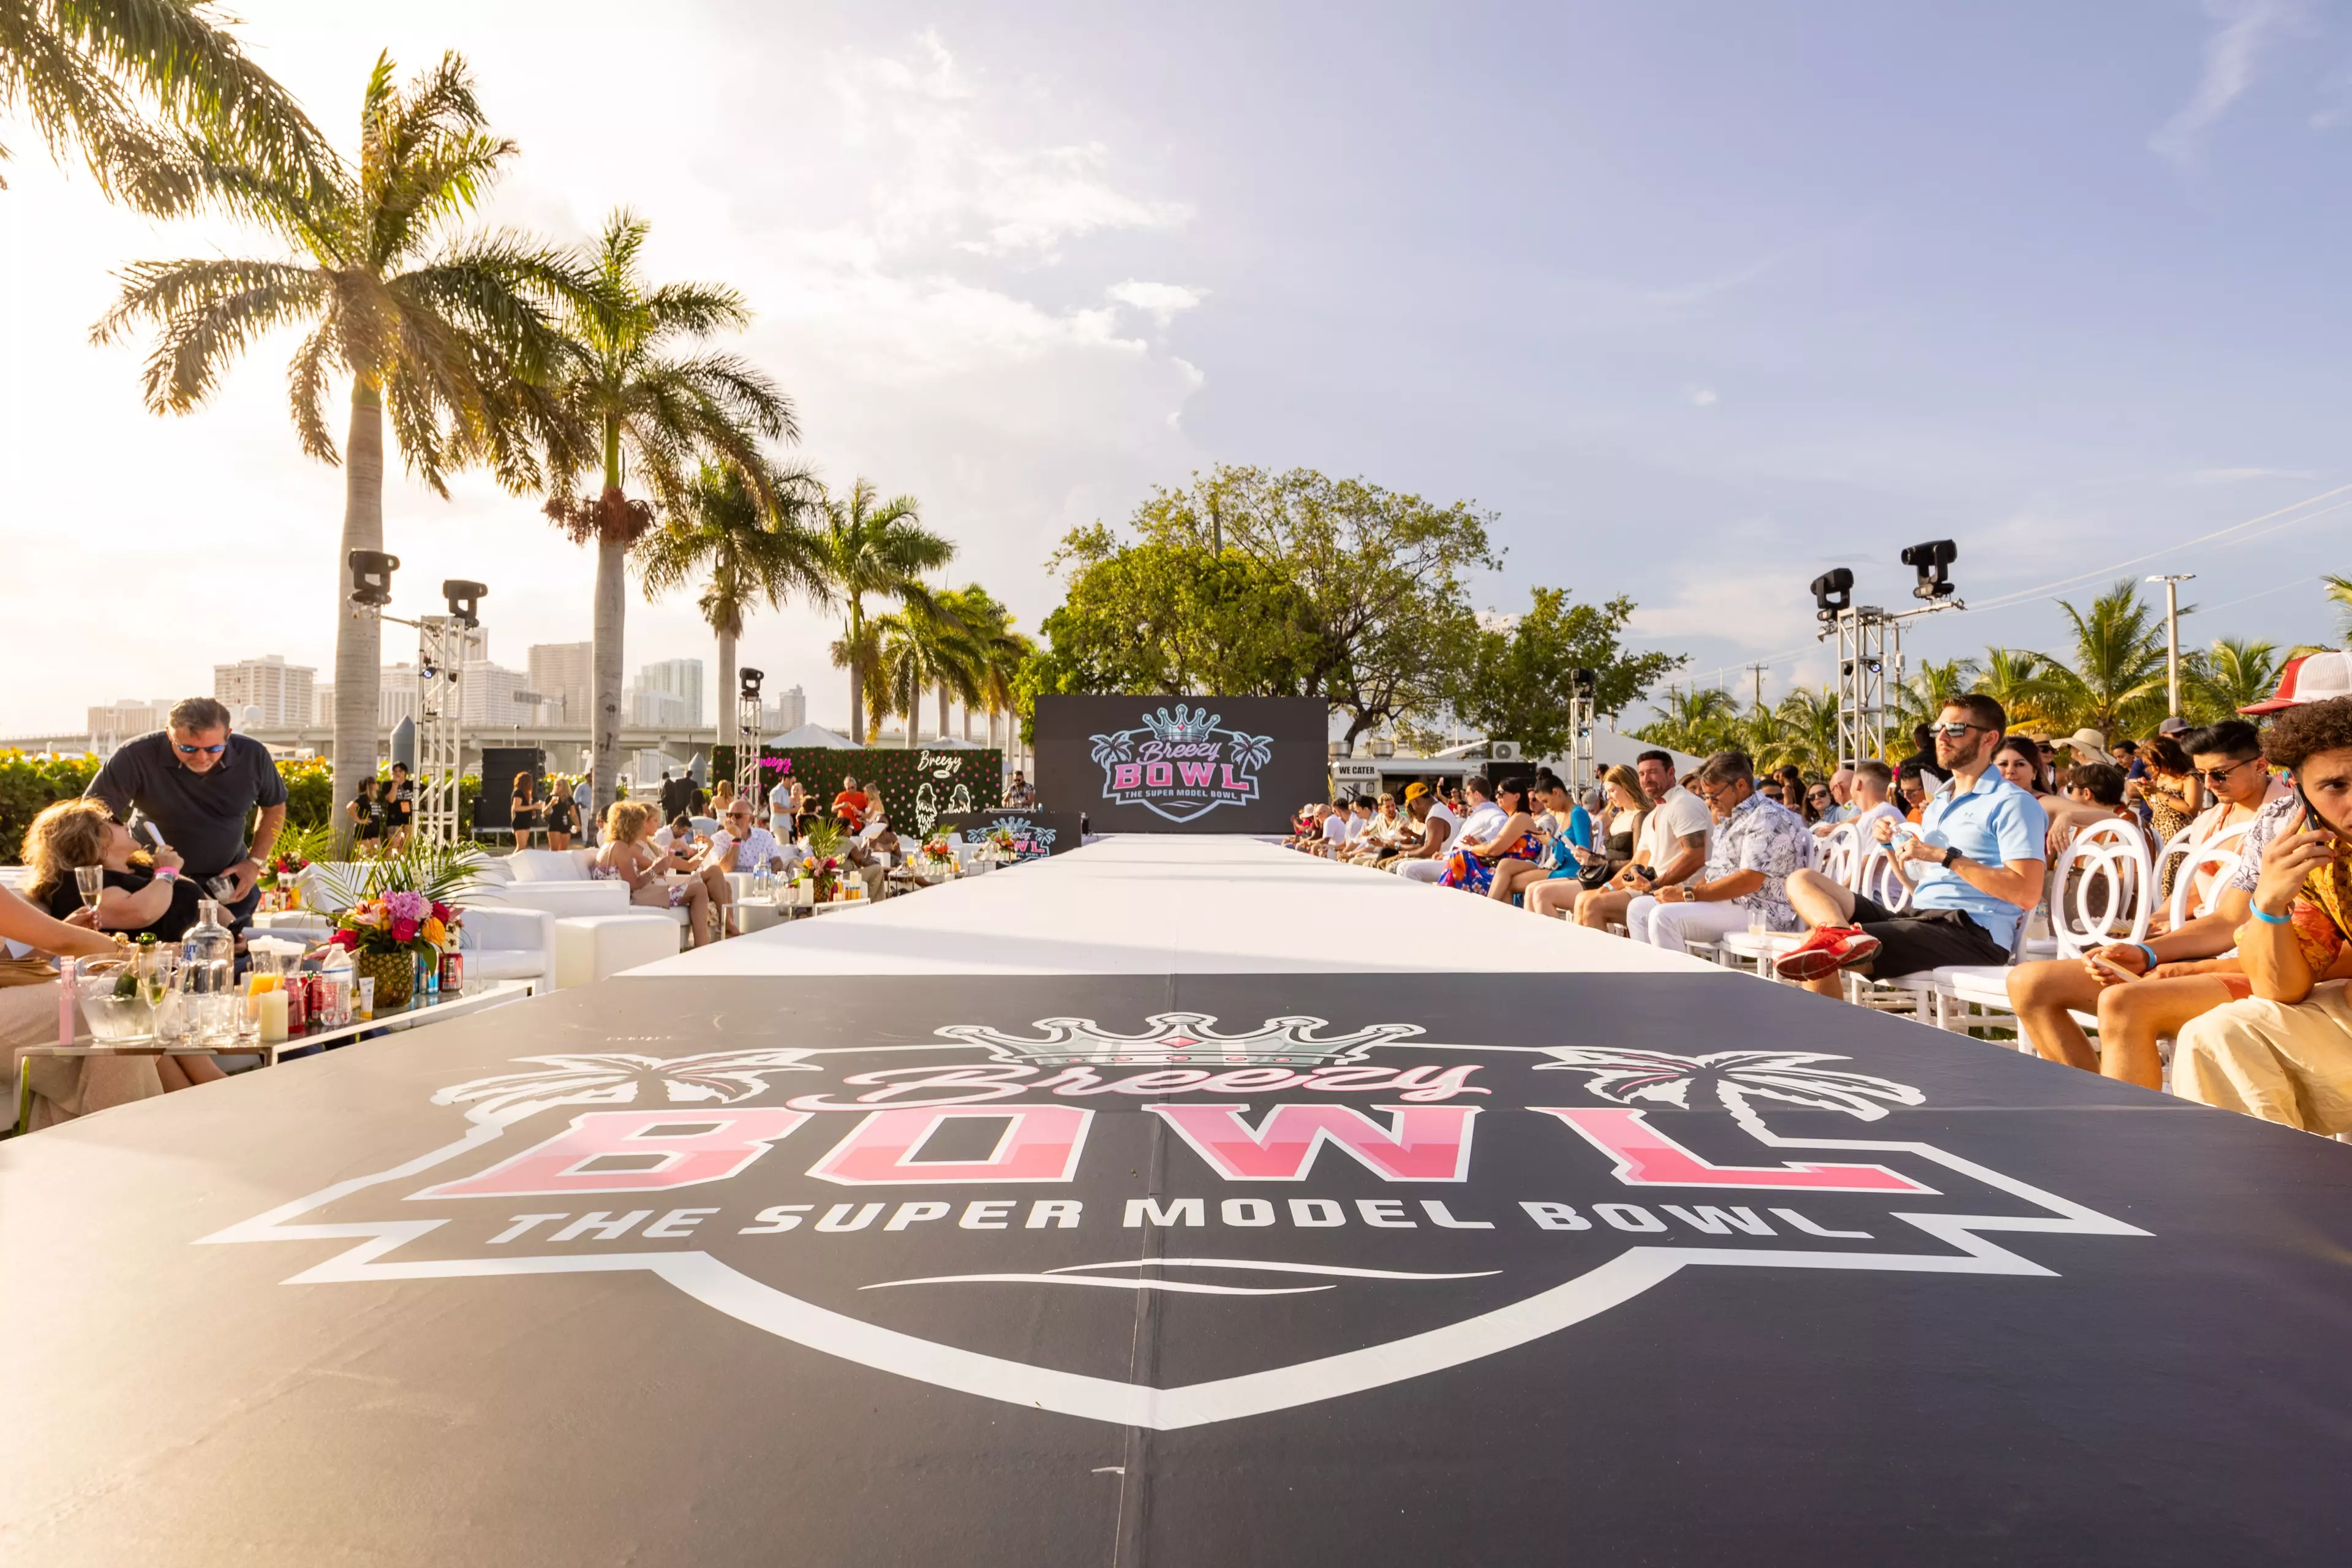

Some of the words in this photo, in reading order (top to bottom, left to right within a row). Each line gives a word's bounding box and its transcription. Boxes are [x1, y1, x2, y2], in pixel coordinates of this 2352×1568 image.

[760, 757, 791, 774] reezy
[918, 750, 962, 773] Breezy
[1136, 741, 1223, 765] Breezy
[1112, 761, 1249, 790] BOWL
[1211, 790, 1237, 799] BOWL
[787, 1065, 1491, 1111] Breezy
[401, 1104, 1944, 1200] BOWL
[486, 1207, 721, 1244] THE
[738, 1199, 1084, 1235] SUPER
[1123, 1199, 1495, 1229] MODEL
[1518, 1201, 1875, 1239] BOWL
